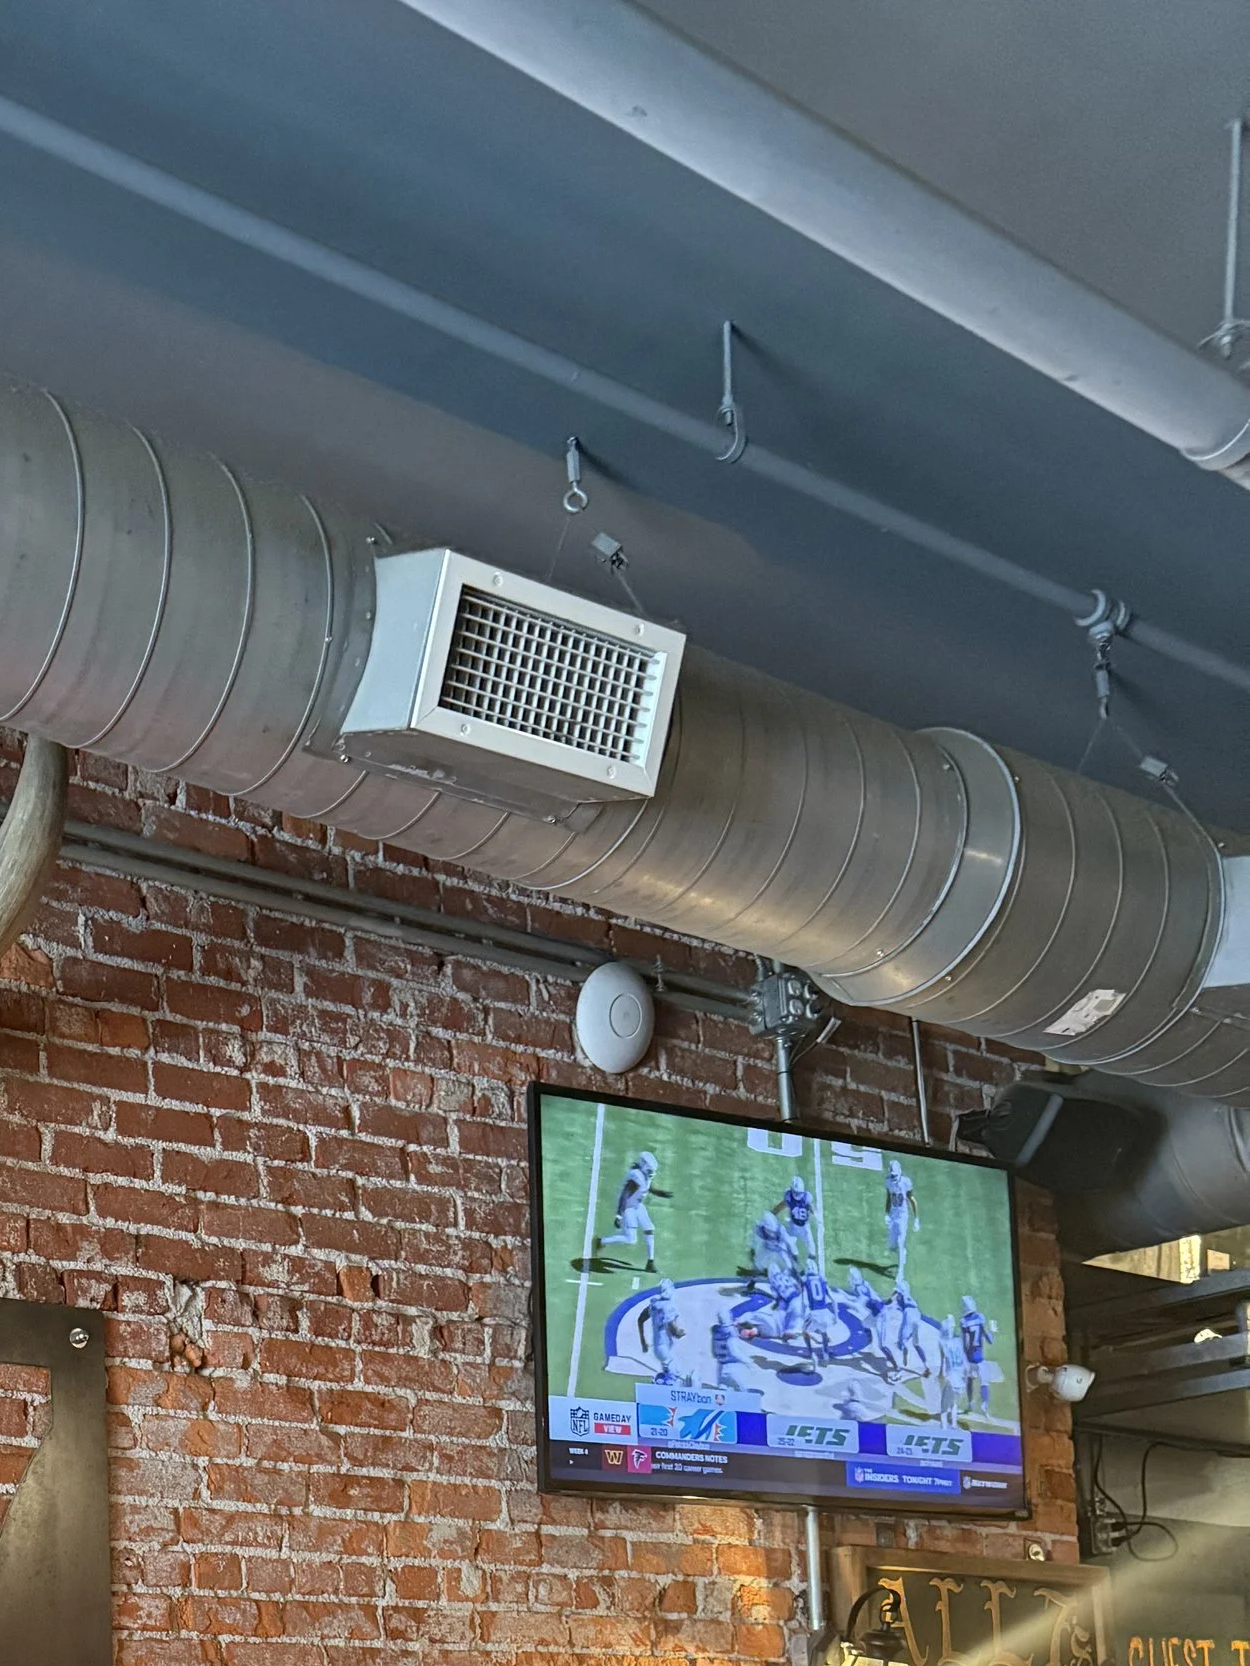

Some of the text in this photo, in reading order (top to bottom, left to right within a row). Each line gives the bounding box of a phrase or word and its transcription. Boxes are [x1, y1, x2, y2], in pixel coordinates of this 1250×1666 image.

[593, 1412, 632, 1424] GAMEDAY
[602, 1424, 623, 1434] VIEW
[655, 1450, 728, 1464] COMMANDERS NOTES
